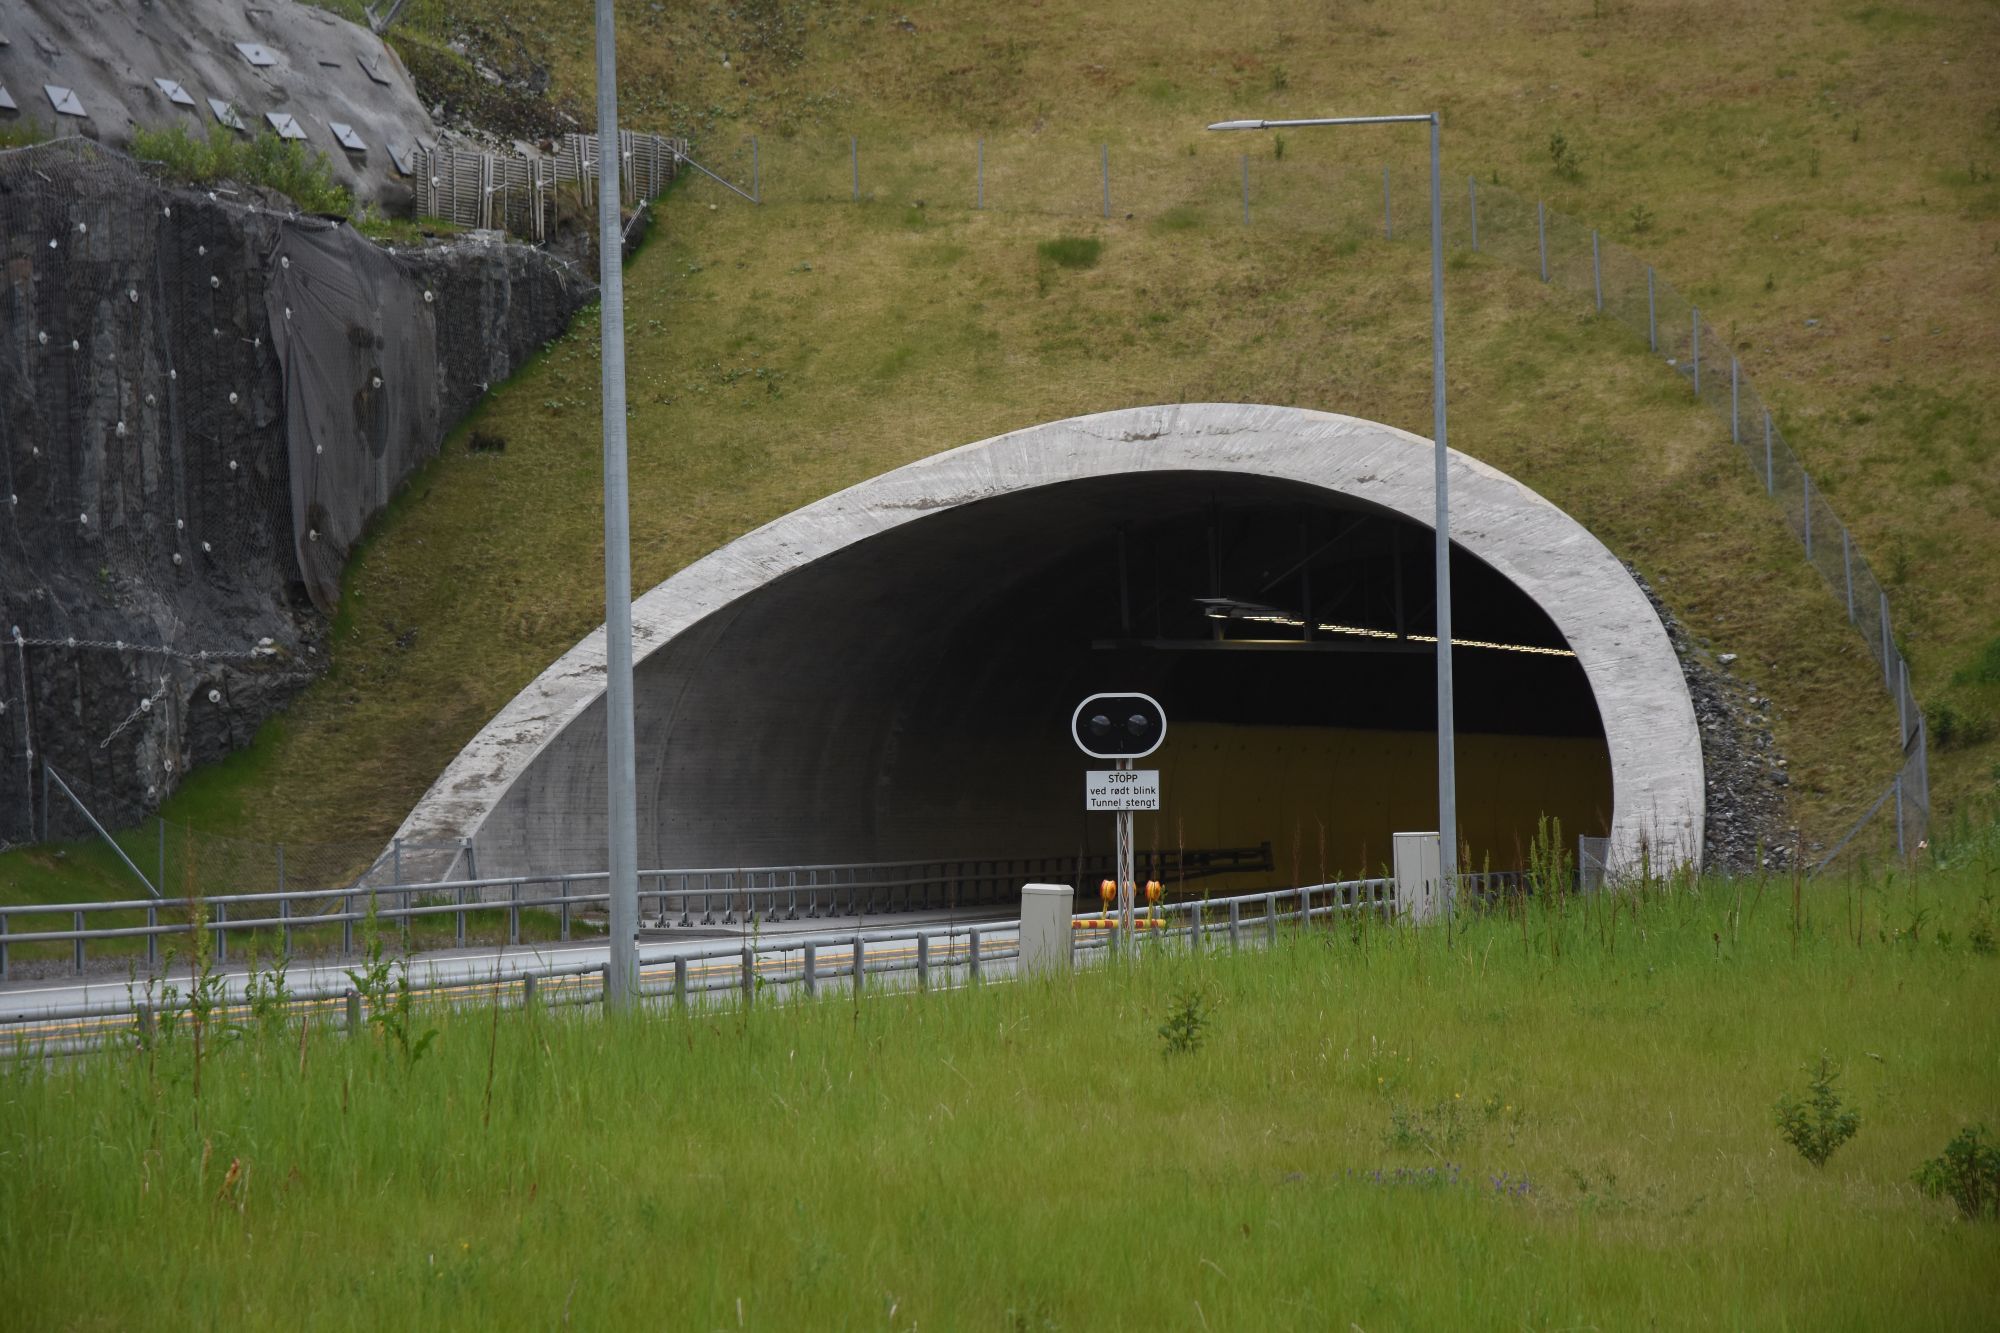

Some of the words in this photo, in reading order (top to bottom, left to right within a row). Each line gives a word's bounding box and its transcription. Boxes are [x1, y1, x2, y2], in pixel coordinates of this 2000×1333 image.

[1108, 774, 1138, 783] STOPP
[1090, 787, 1106, 795] ved
[1111, 787, 1130, 795] rødt
[1133, 786, 1156, 795] blink
[1091, 798, 1121, 807] Tunnel
[1126, 798, 1156, 808] stengt
